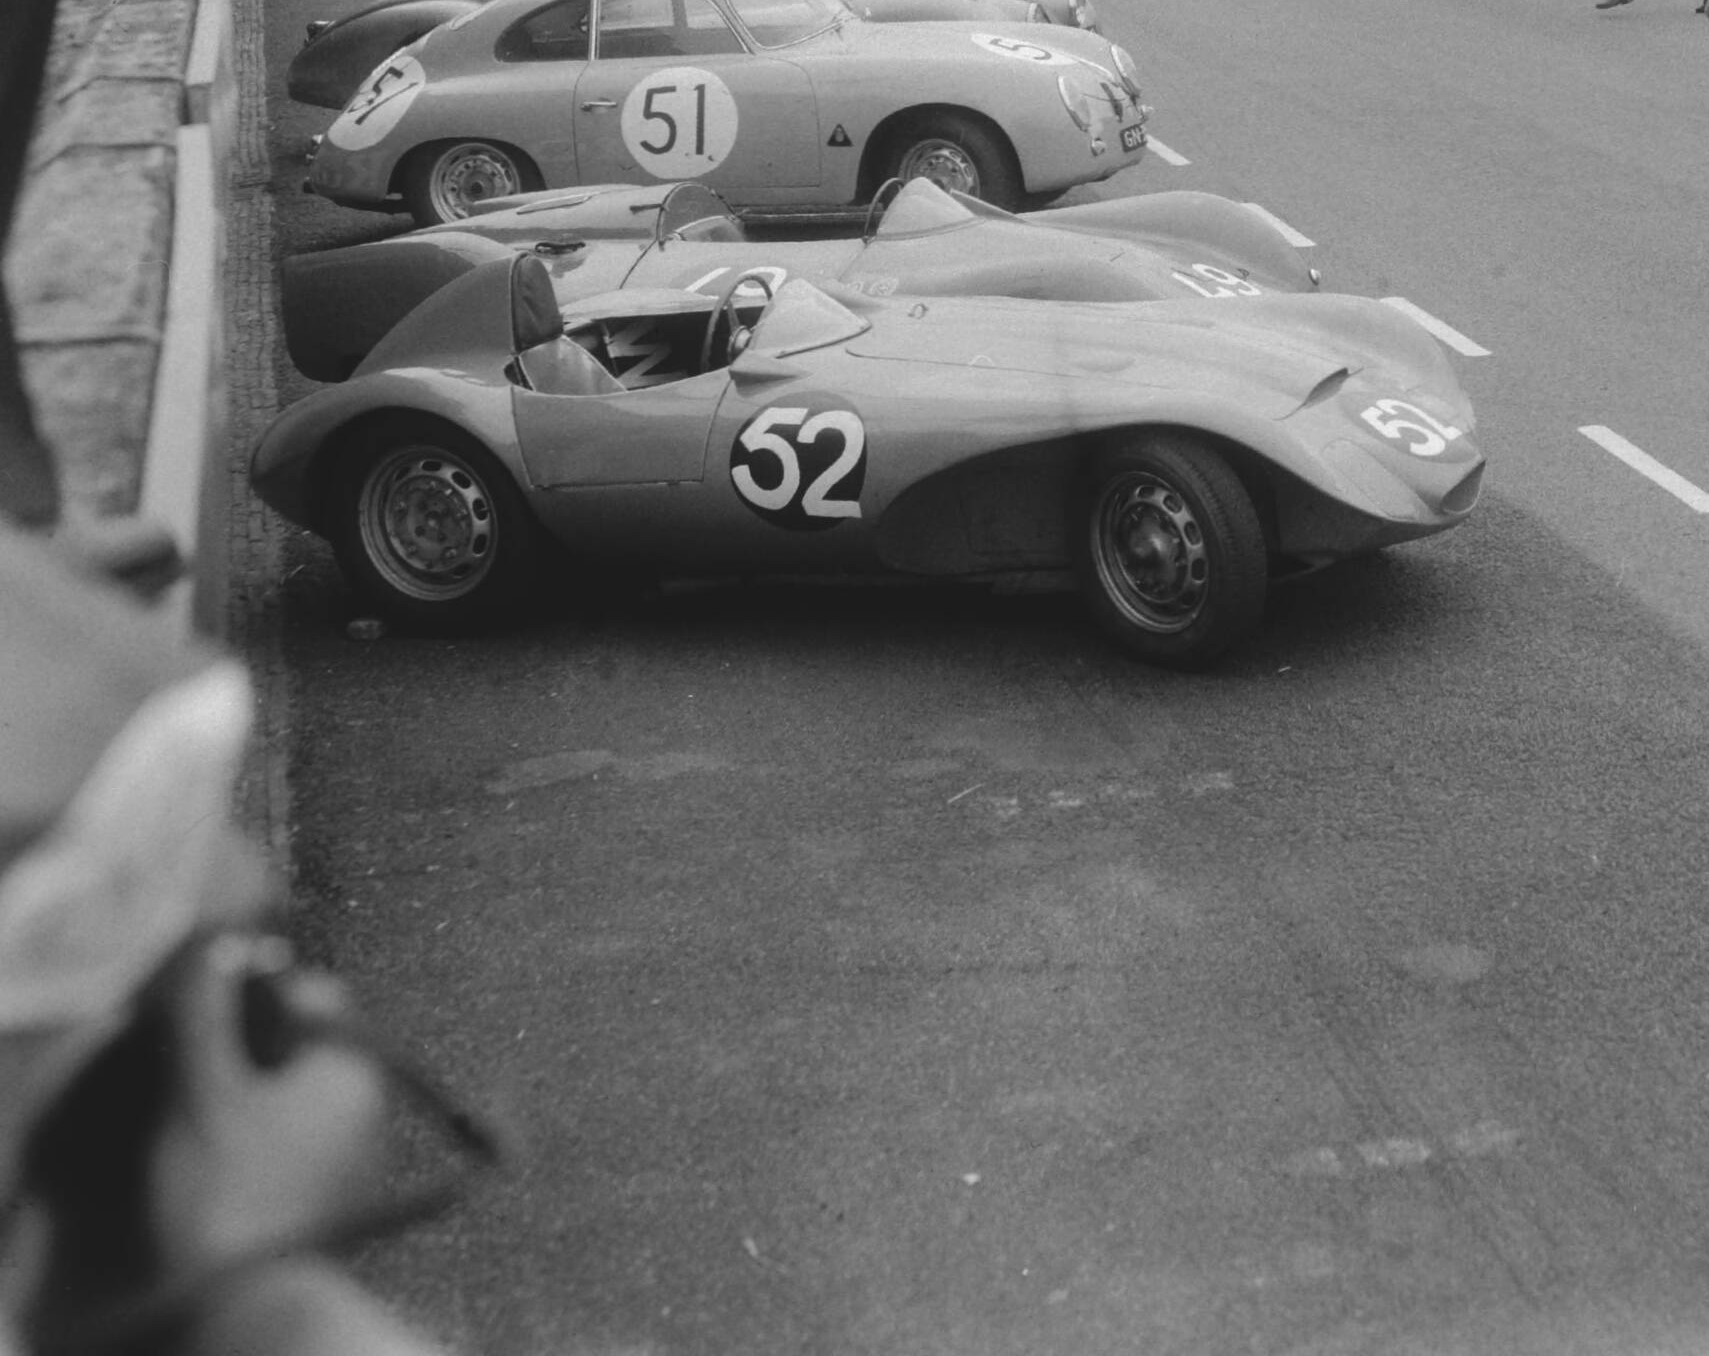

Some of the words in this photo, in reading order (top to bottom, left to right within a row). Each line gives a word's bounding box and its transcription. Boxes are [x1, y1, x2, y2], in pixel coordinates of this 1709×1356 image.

[639, 83, 706, 155] 51
[731, 407, 863, 519] 52
[1360, 398, 1463, 457] 52
